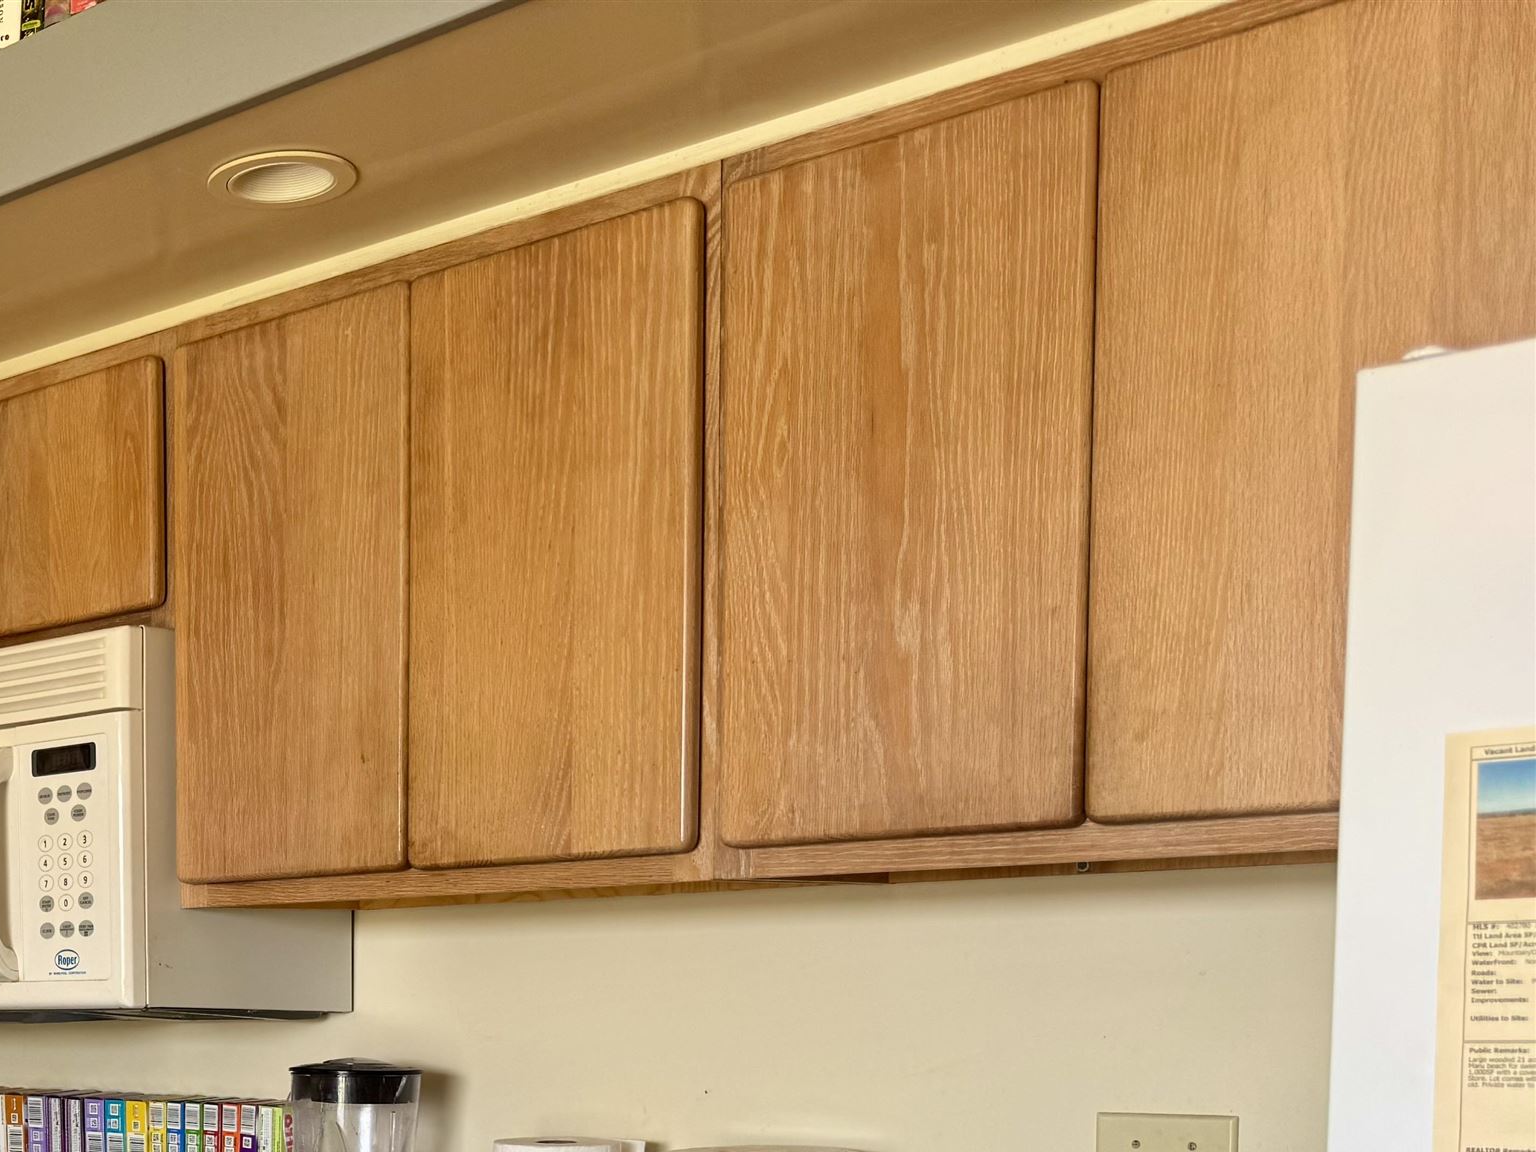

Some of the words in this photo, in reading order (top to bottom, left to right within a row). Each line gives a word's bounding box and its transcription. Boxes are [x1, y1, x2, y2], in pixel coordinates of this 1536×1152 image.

[1484, 747, 1513, 756] Vacant
[1514, 744, 1536, 753] Land
[57, 954, 77, 967] Roper
